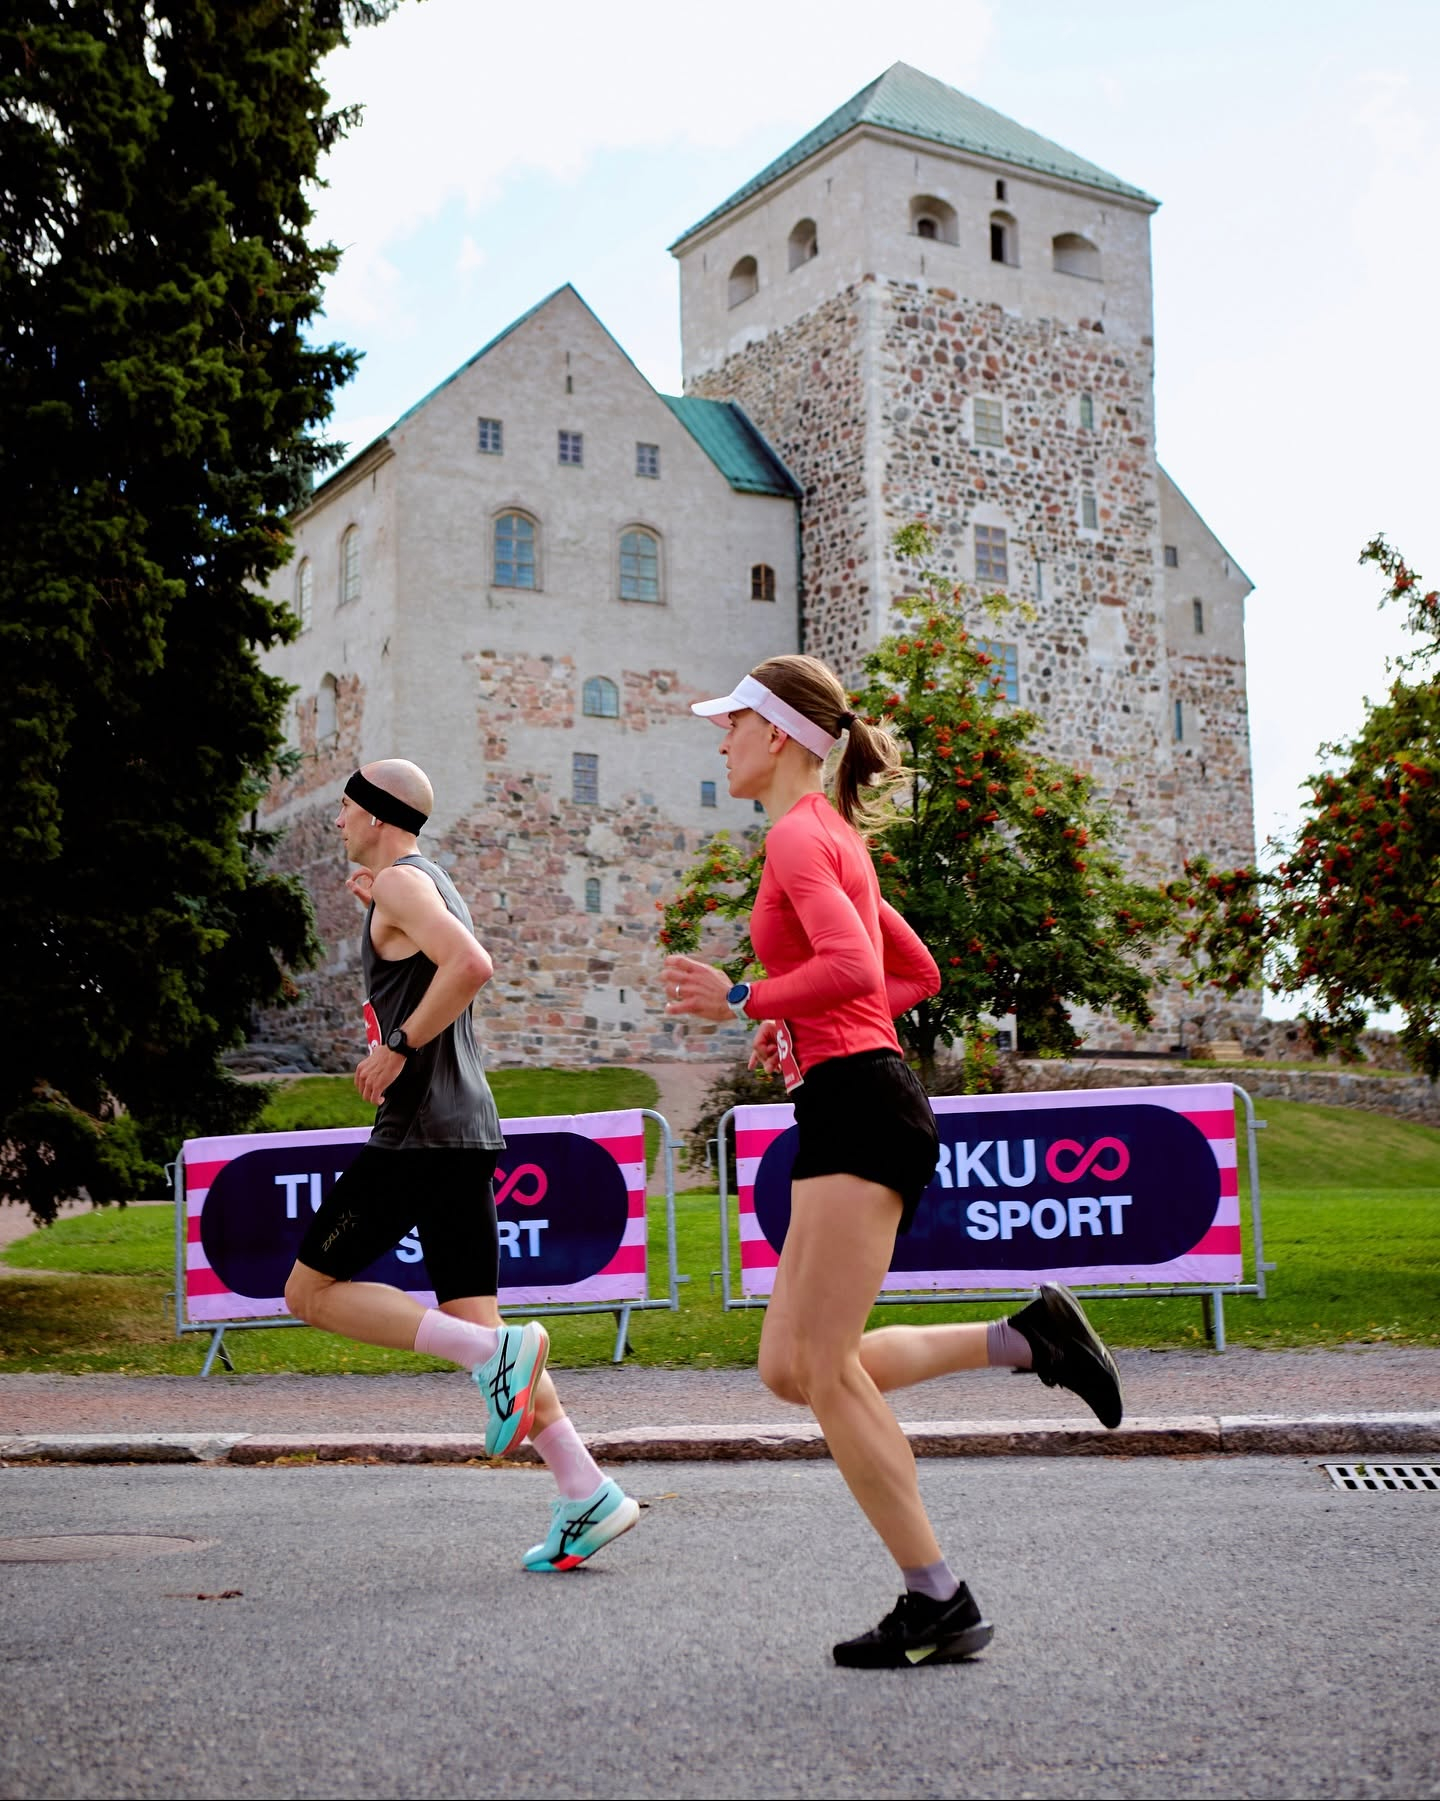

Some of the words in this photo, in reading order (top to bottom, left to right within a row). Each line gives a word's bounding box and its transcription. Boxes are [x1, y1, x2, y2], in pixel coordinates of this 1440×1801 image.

[924, 1138, 1037, 1189] RKU
[966, 1195, 1133, 1241] SPORT
[394, 1219, 549, 1264] SRT
